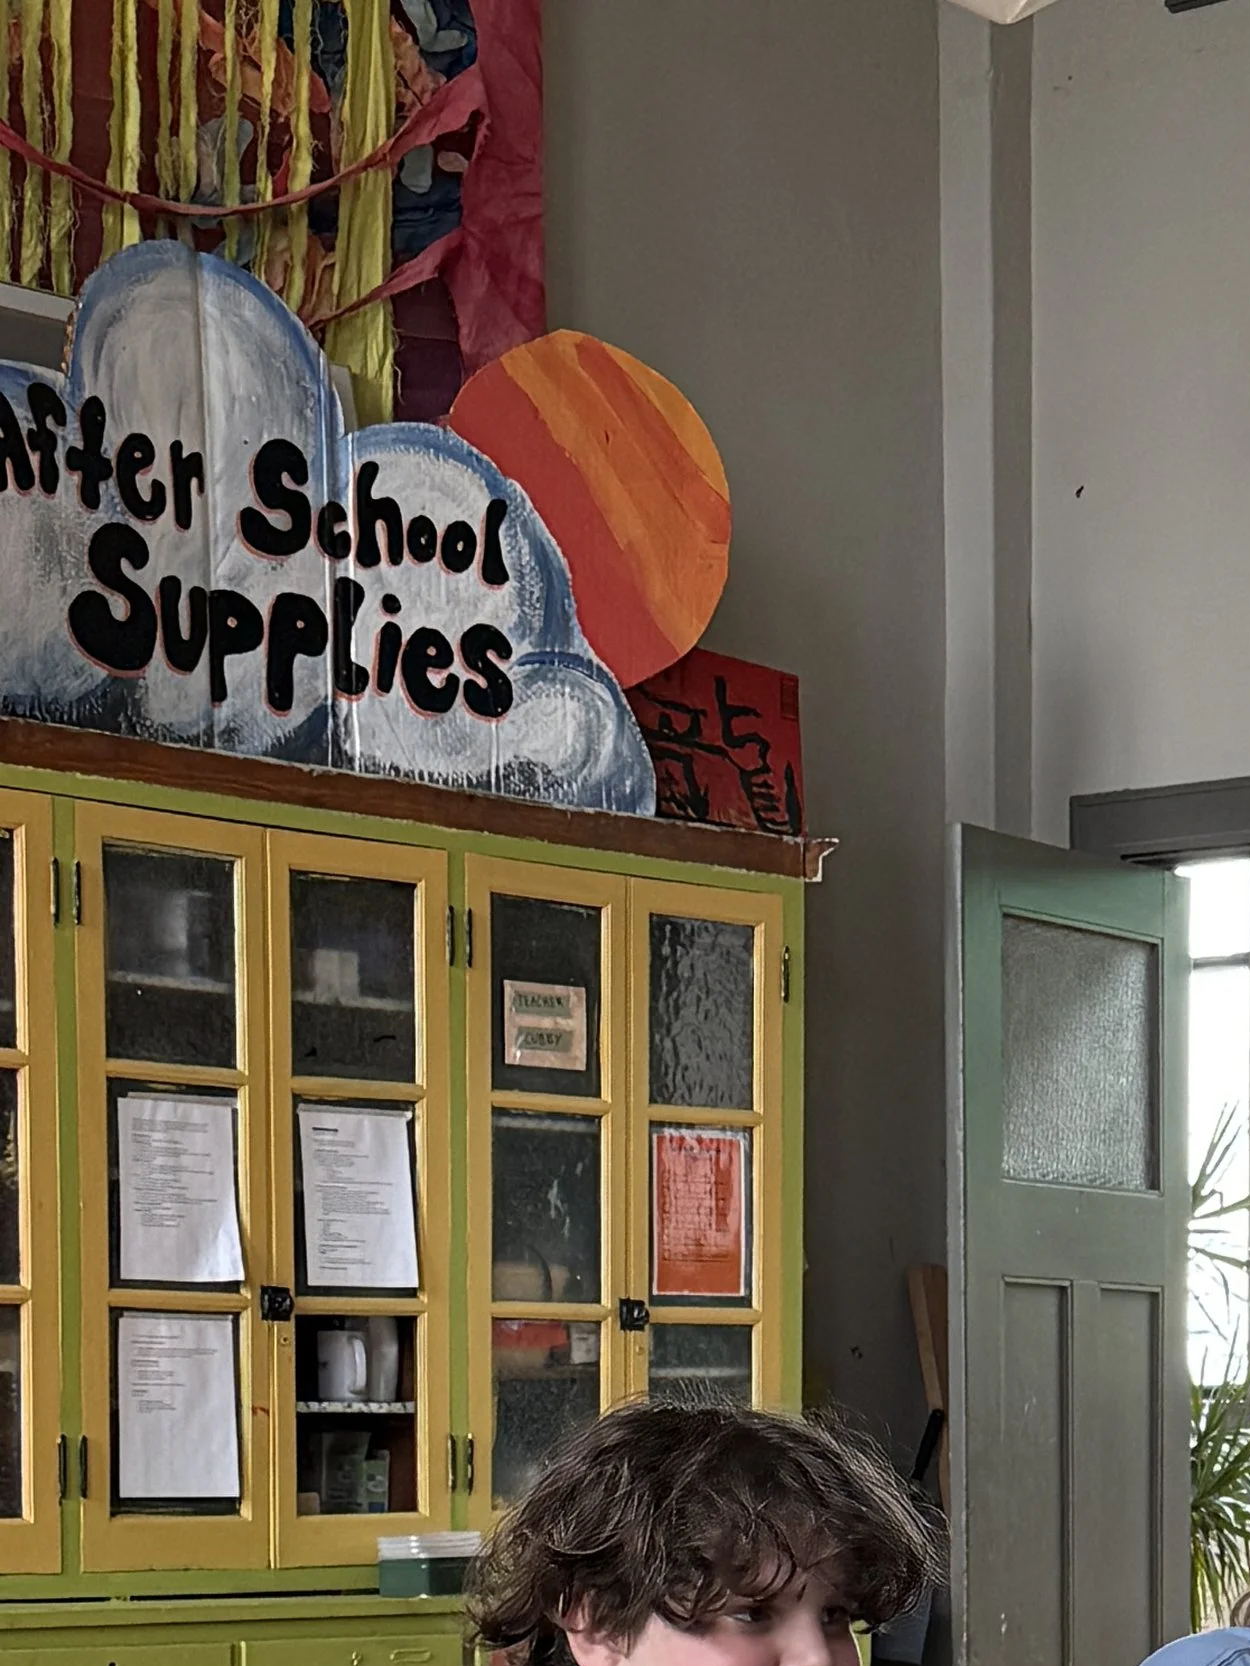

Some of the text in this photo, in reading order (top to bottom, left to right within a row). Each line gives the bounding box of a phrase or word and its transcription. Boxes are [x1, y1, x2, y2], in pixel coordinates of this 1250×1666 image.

[0, 382, 510, 587] After School
[69, 522, 514, 719] Supplies
